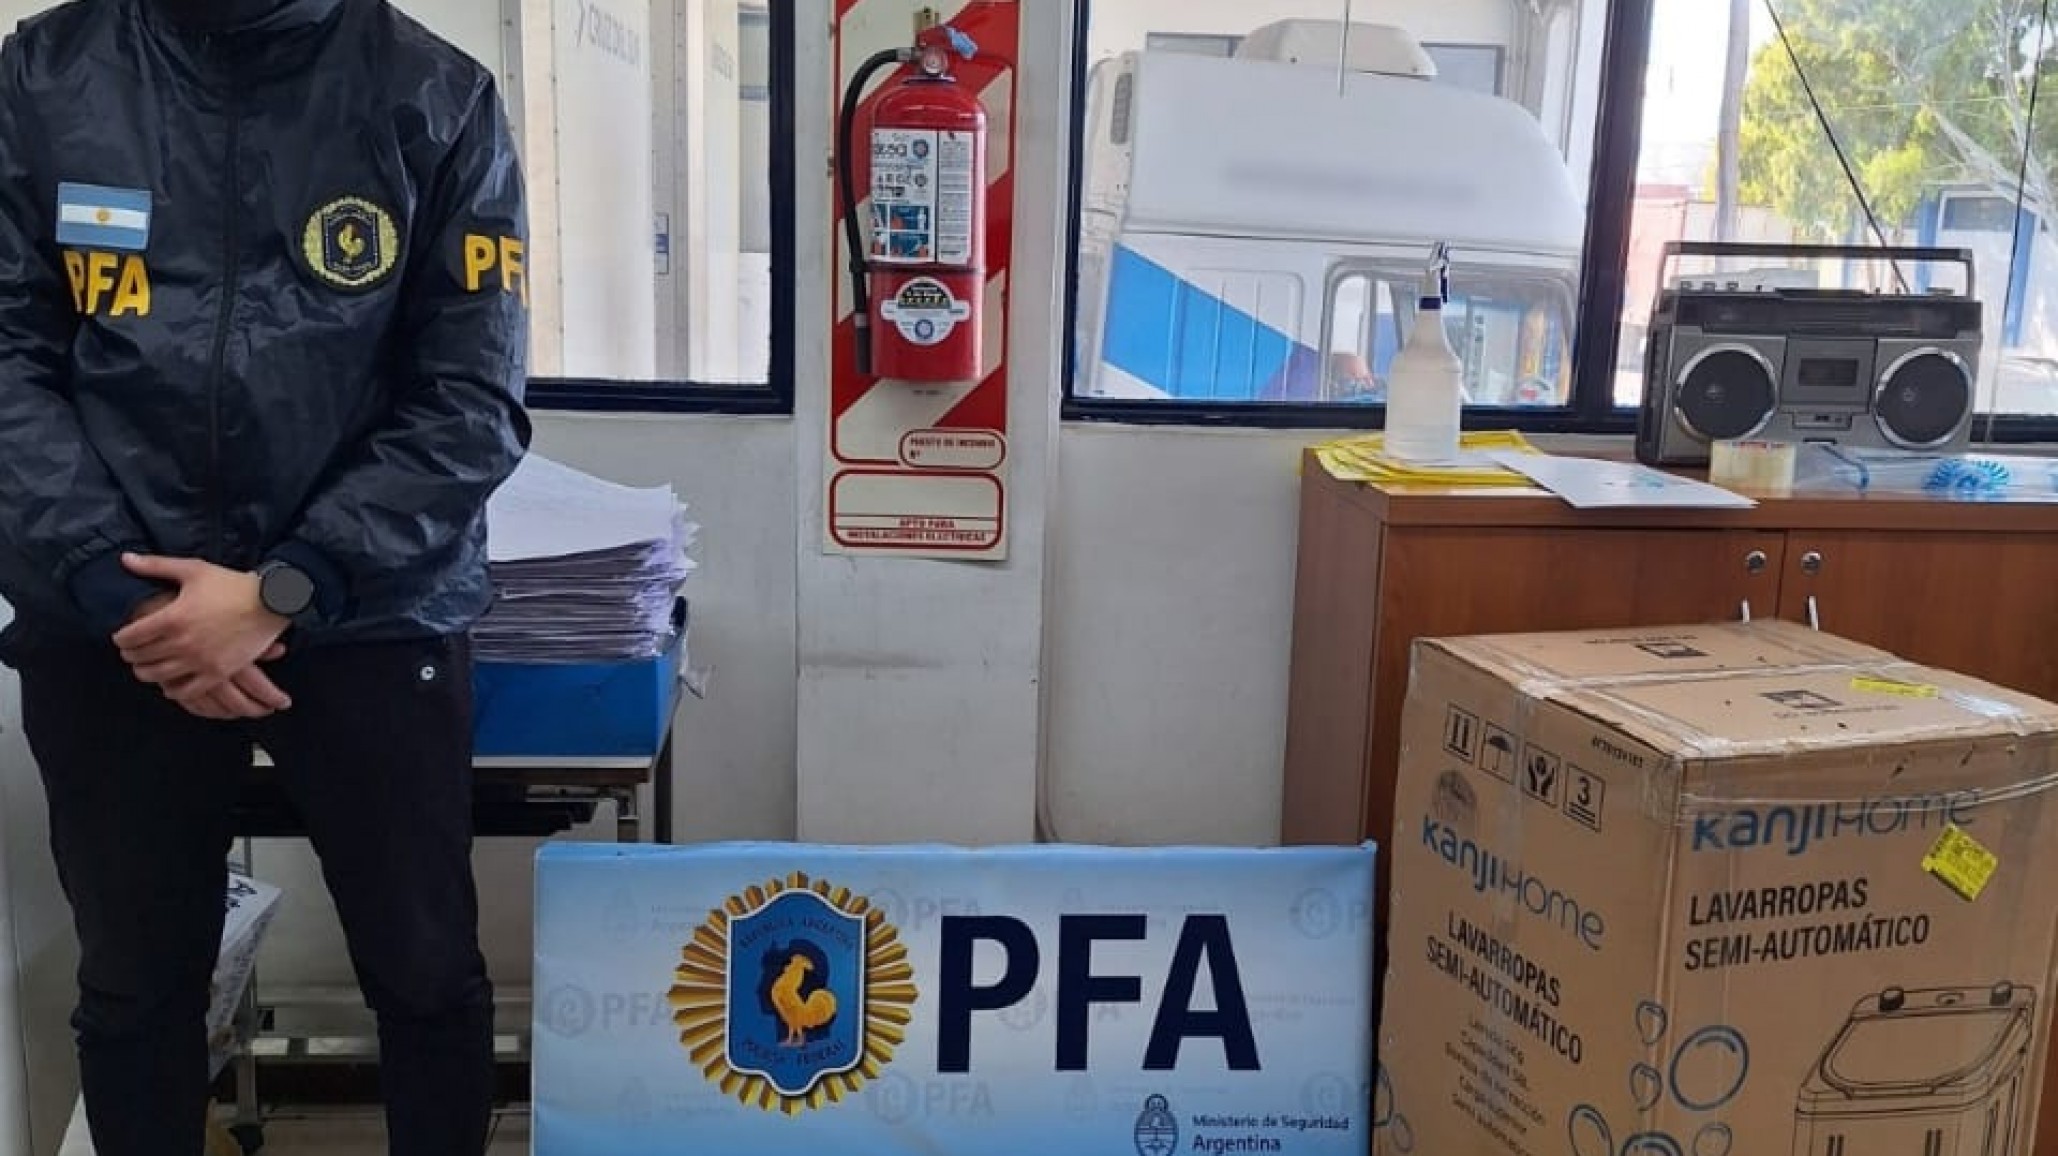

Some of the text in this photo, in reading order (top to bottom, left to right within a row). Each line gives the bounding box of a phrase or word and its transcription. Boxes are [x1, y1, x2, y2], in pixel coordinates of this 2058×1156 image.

[63, 250, 151, 317] PFA
[1688, 876, 1869, 927] LAVARROPAS
[1448, 910, 1561, 1008] LAVARROPAS
[1683, 912, 1931, 972] SEMI-AUTOMÁTICO
[936, 913, 1262, 1073] PFA
[1426, 934, 1582, 1065] SEMI-AUTOMÁTICO
[1192, 1113, 1349, 1131] Ministerio de Seguridad
[1192, 1133, 1281, 1153] Argentina
